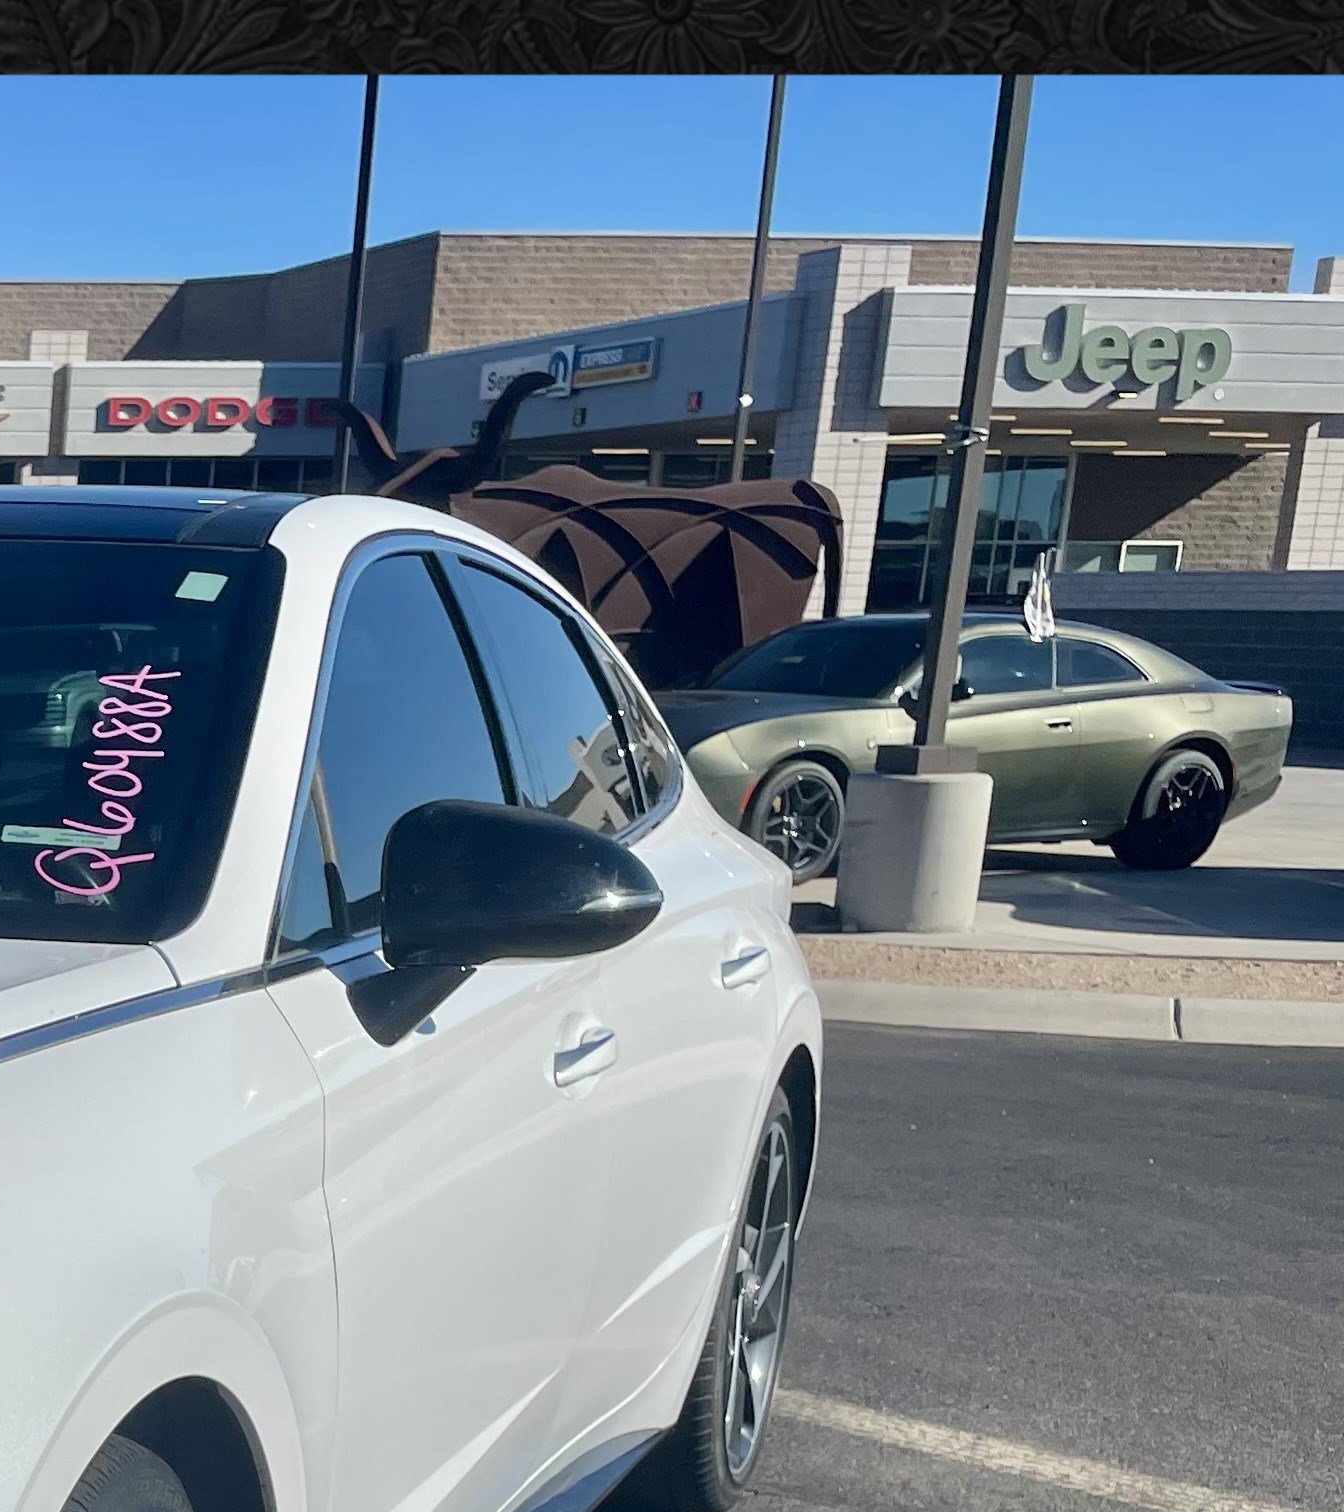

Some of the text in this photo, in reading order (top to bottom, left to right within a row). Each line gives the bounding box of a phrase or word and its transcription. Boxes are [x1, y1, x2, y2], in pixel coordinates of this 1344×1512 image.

[1025, 304, 1232, 401] Jeep
[108, 396, 341, 428] DODGE
[34, 664, 182, 896] Q60488A
